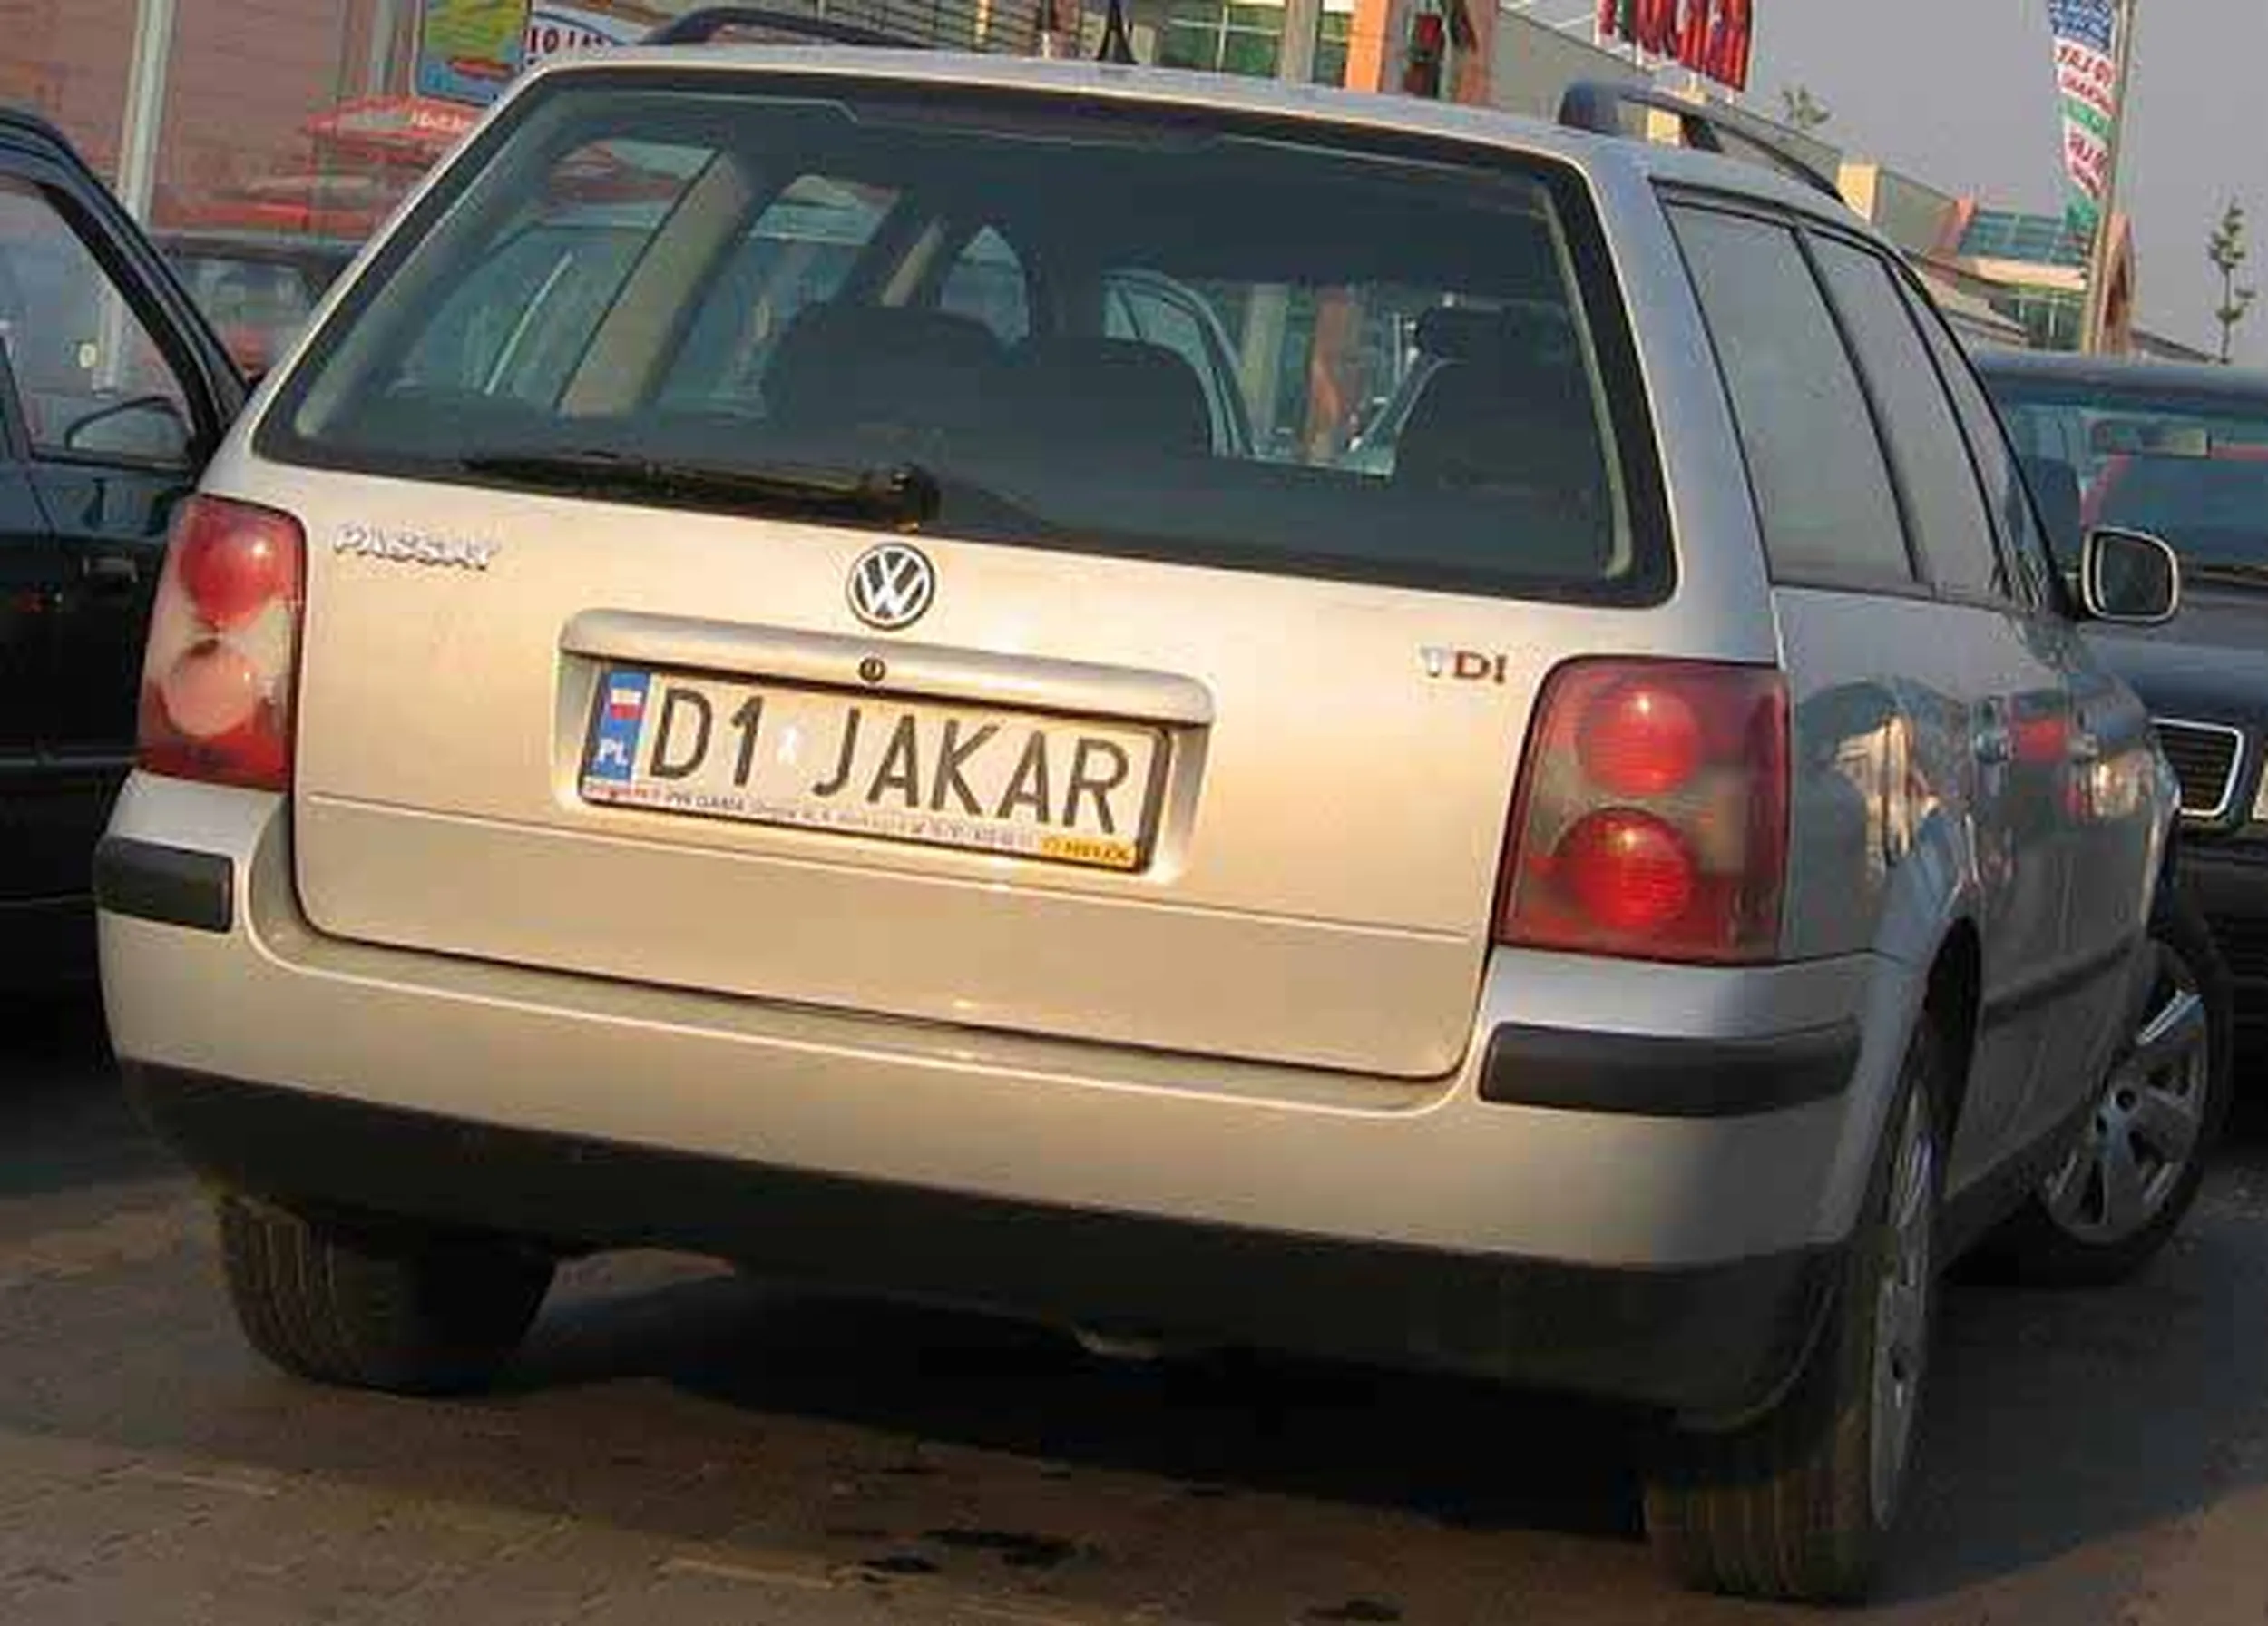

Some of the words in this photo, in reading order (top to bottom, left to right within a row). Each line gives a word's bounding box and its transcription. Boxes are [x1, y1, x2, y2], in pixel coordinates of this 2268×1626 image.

[1420, 645, 1508, 684] TDI
[597, 736, 629, 767] PL
[648, 687, 763, 787] D1
[811, 705, 1129, 833] JAKAR
